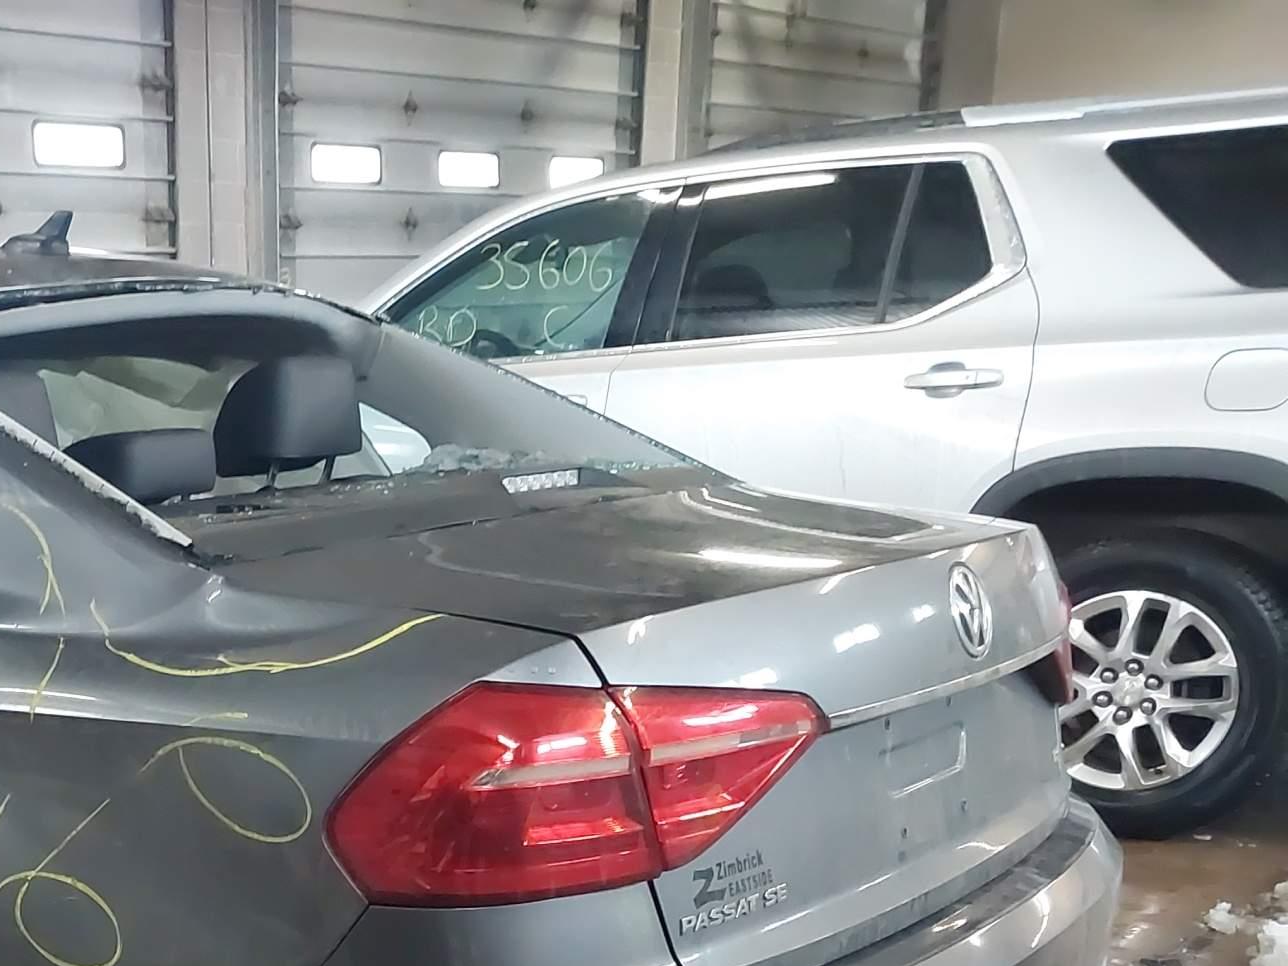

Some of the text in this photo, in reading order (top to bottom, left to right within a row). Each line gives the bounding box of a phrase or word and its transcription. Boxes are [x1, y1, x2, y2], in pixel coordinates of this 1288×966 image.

[475, 238, 613, 292] 35606
[715, 849, 764, 880] Zimbrick
[728, 868, 774, 897] EASTSIDE
[679, 882, 788, 936] PASSAT SE
